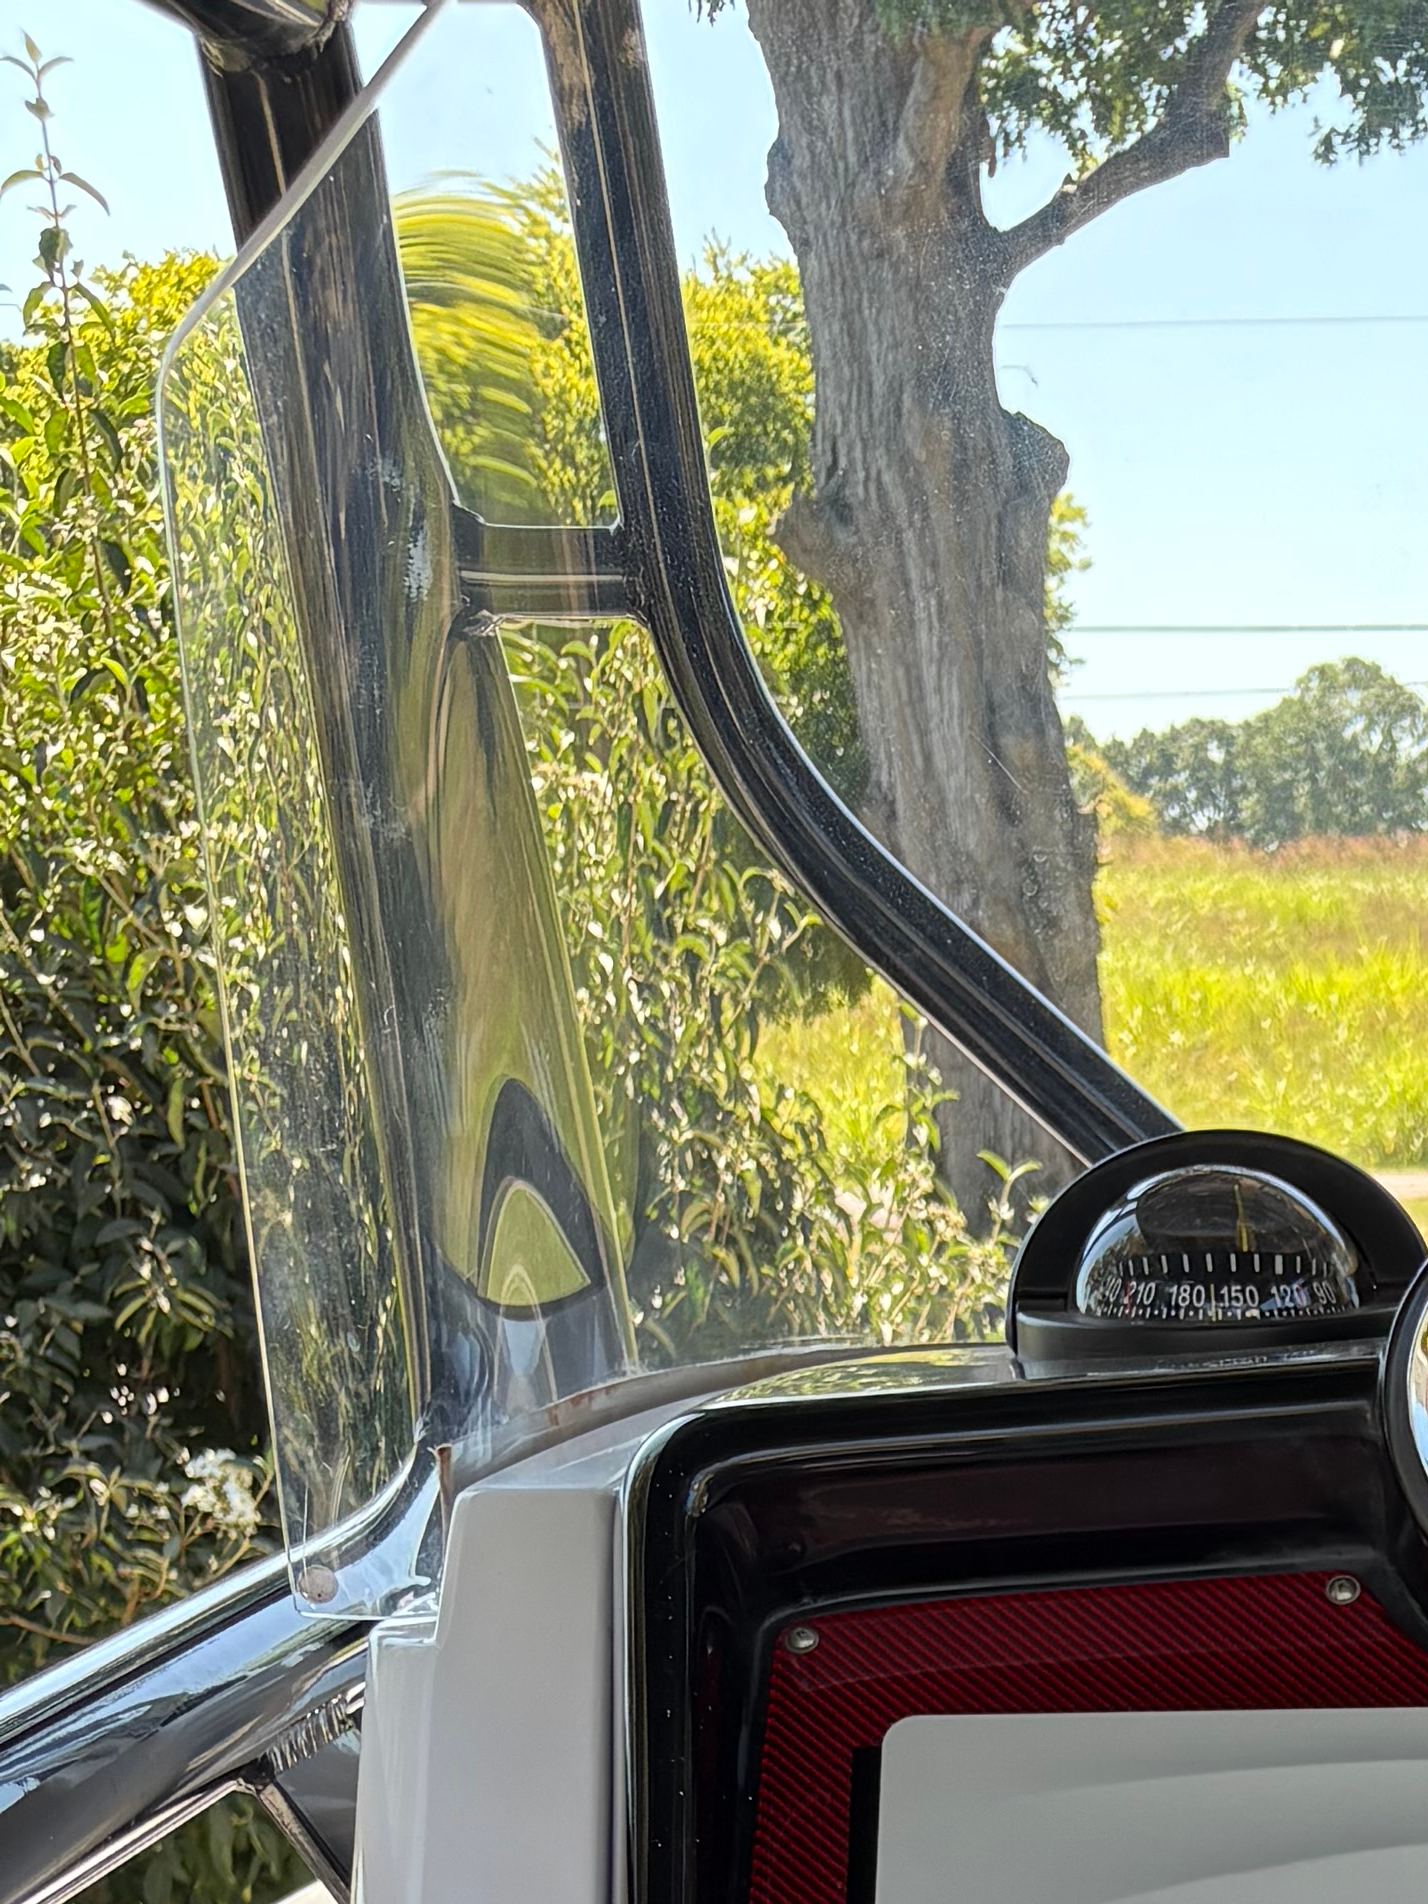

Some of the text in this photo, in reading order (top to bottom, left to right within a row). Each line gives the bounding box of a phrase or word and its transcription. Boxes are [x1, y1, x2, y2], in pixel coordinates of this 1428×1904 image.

[1169, 1284, 1205, 1306] 180
[1220, 1285, 1259, 1306] 150
[1271, 1285, 1308, 1305] 120
[1314, 1282, 1336, 1304] 90
